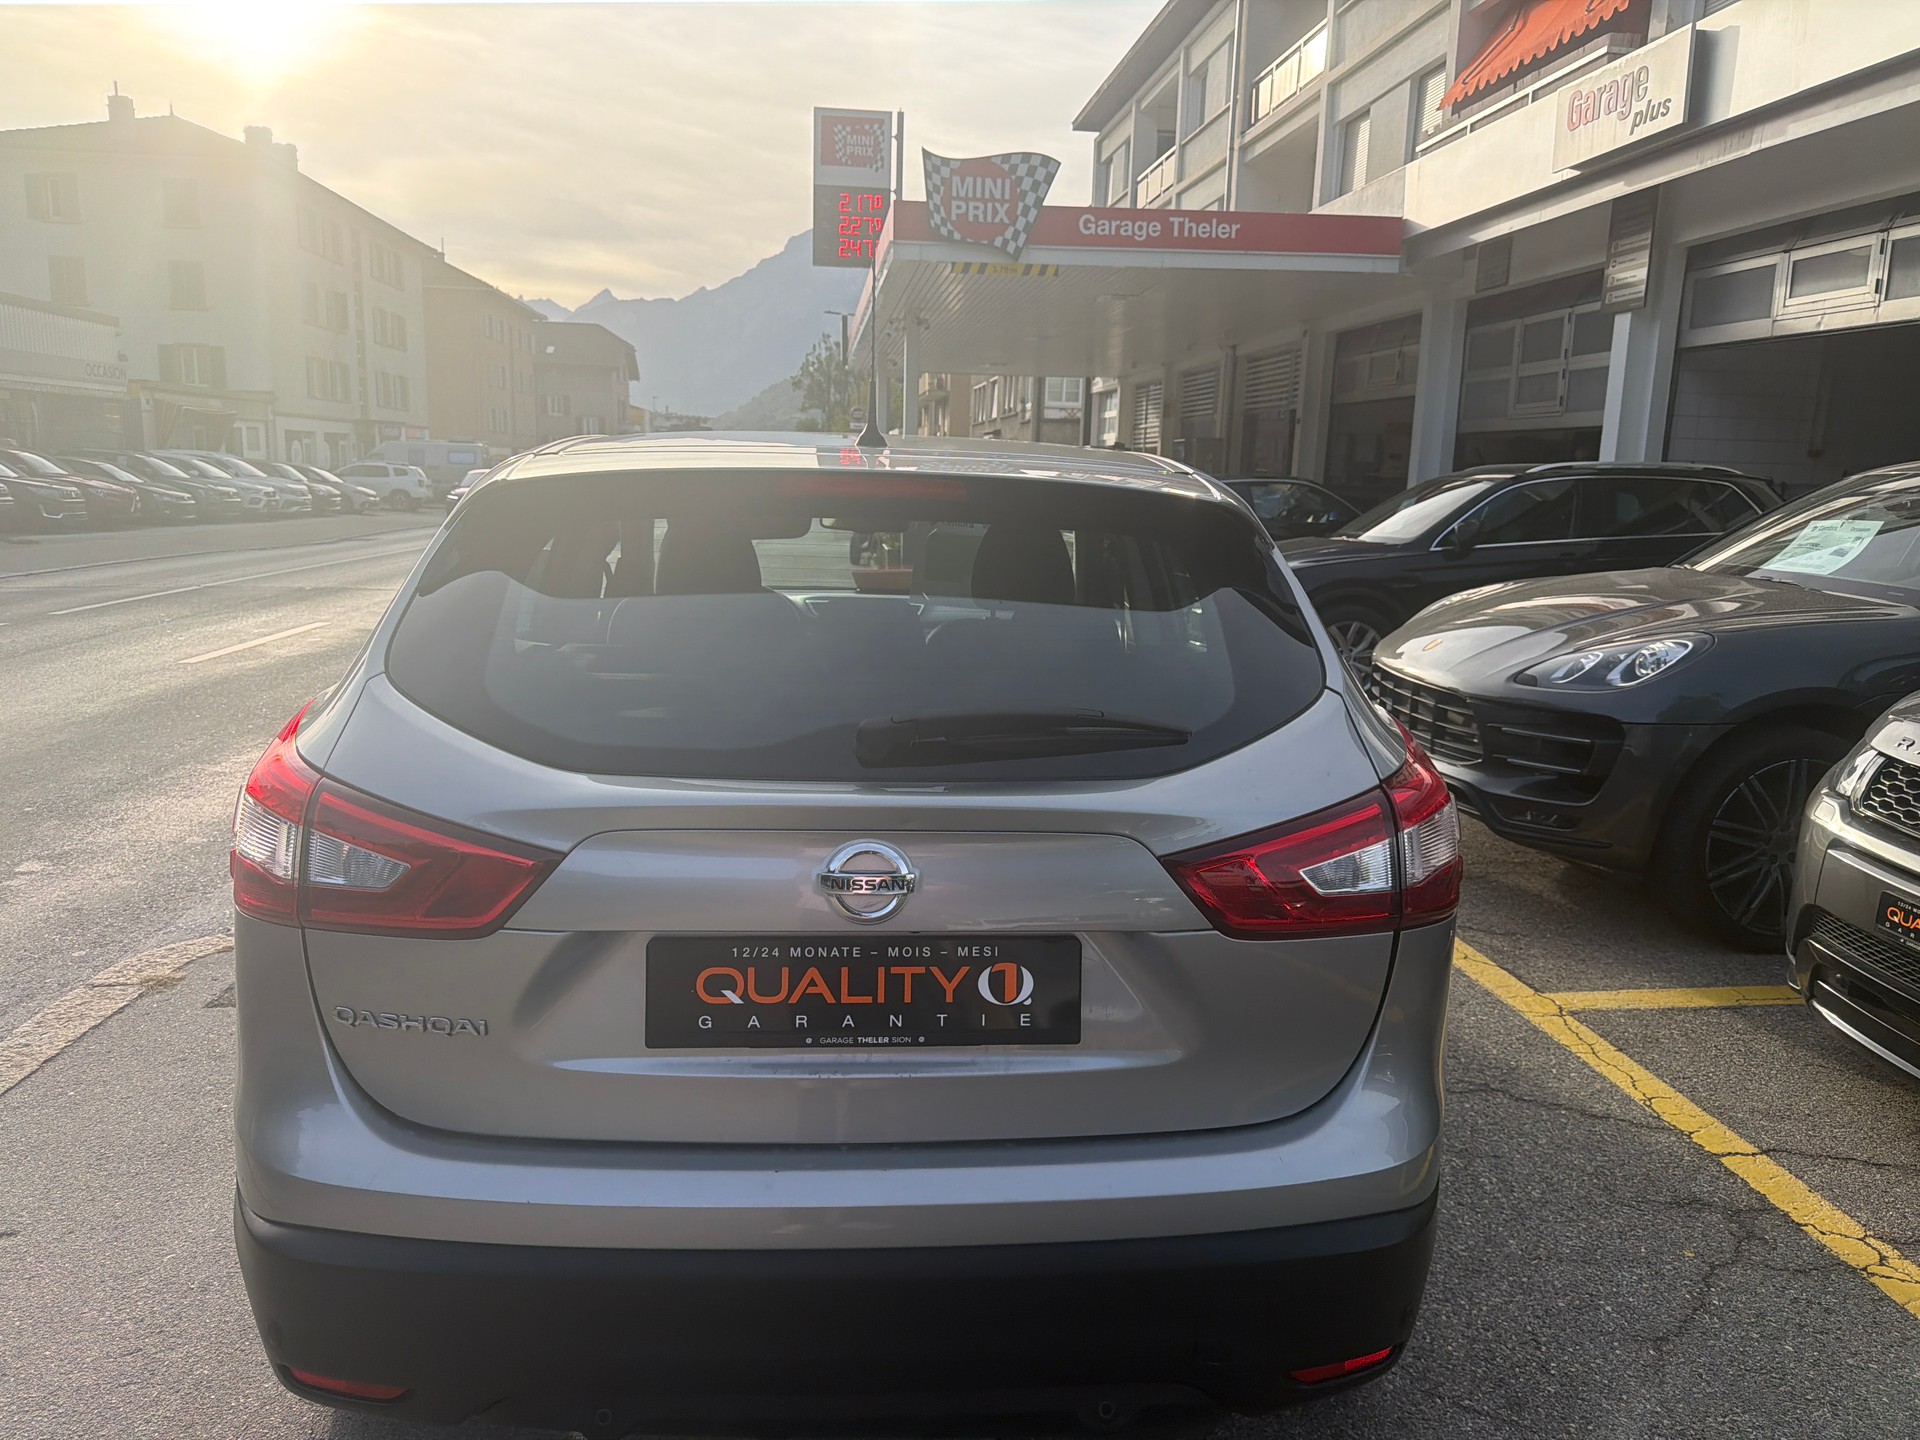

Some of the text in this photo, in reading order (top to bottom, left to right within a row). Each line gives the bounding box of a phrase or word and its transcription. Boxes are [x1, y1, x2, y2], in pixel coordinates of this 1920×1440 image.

[1567, 65, 1650, 132] Garage
[1629, 94, 1672, 136] plus
[846, 134, 874, 146] MINI
[846, 145, 874, 158] PRIX
[950, 176, 1012, 199] MINI
[950, 202, 1011, 224] PRIX
[1078, 214, 1241, 241] Garage Theler
[838, 238, 880, 258] 2.47
[830, 879, 905, 891] NISSAN
[731, 947, 781, 959] 12/24
[789, 946, 862, 959] MONATE
[887, 946, 932, 958] MOIS
[957, 945, 1000, 958] MESI
[695, 965, 970, 1005] QUALITY
[333, 1005, 489, 1037] QASHQAI
[857, 1036, 890, 1044] THELER
[891, 1036, 912, 1044] SION
